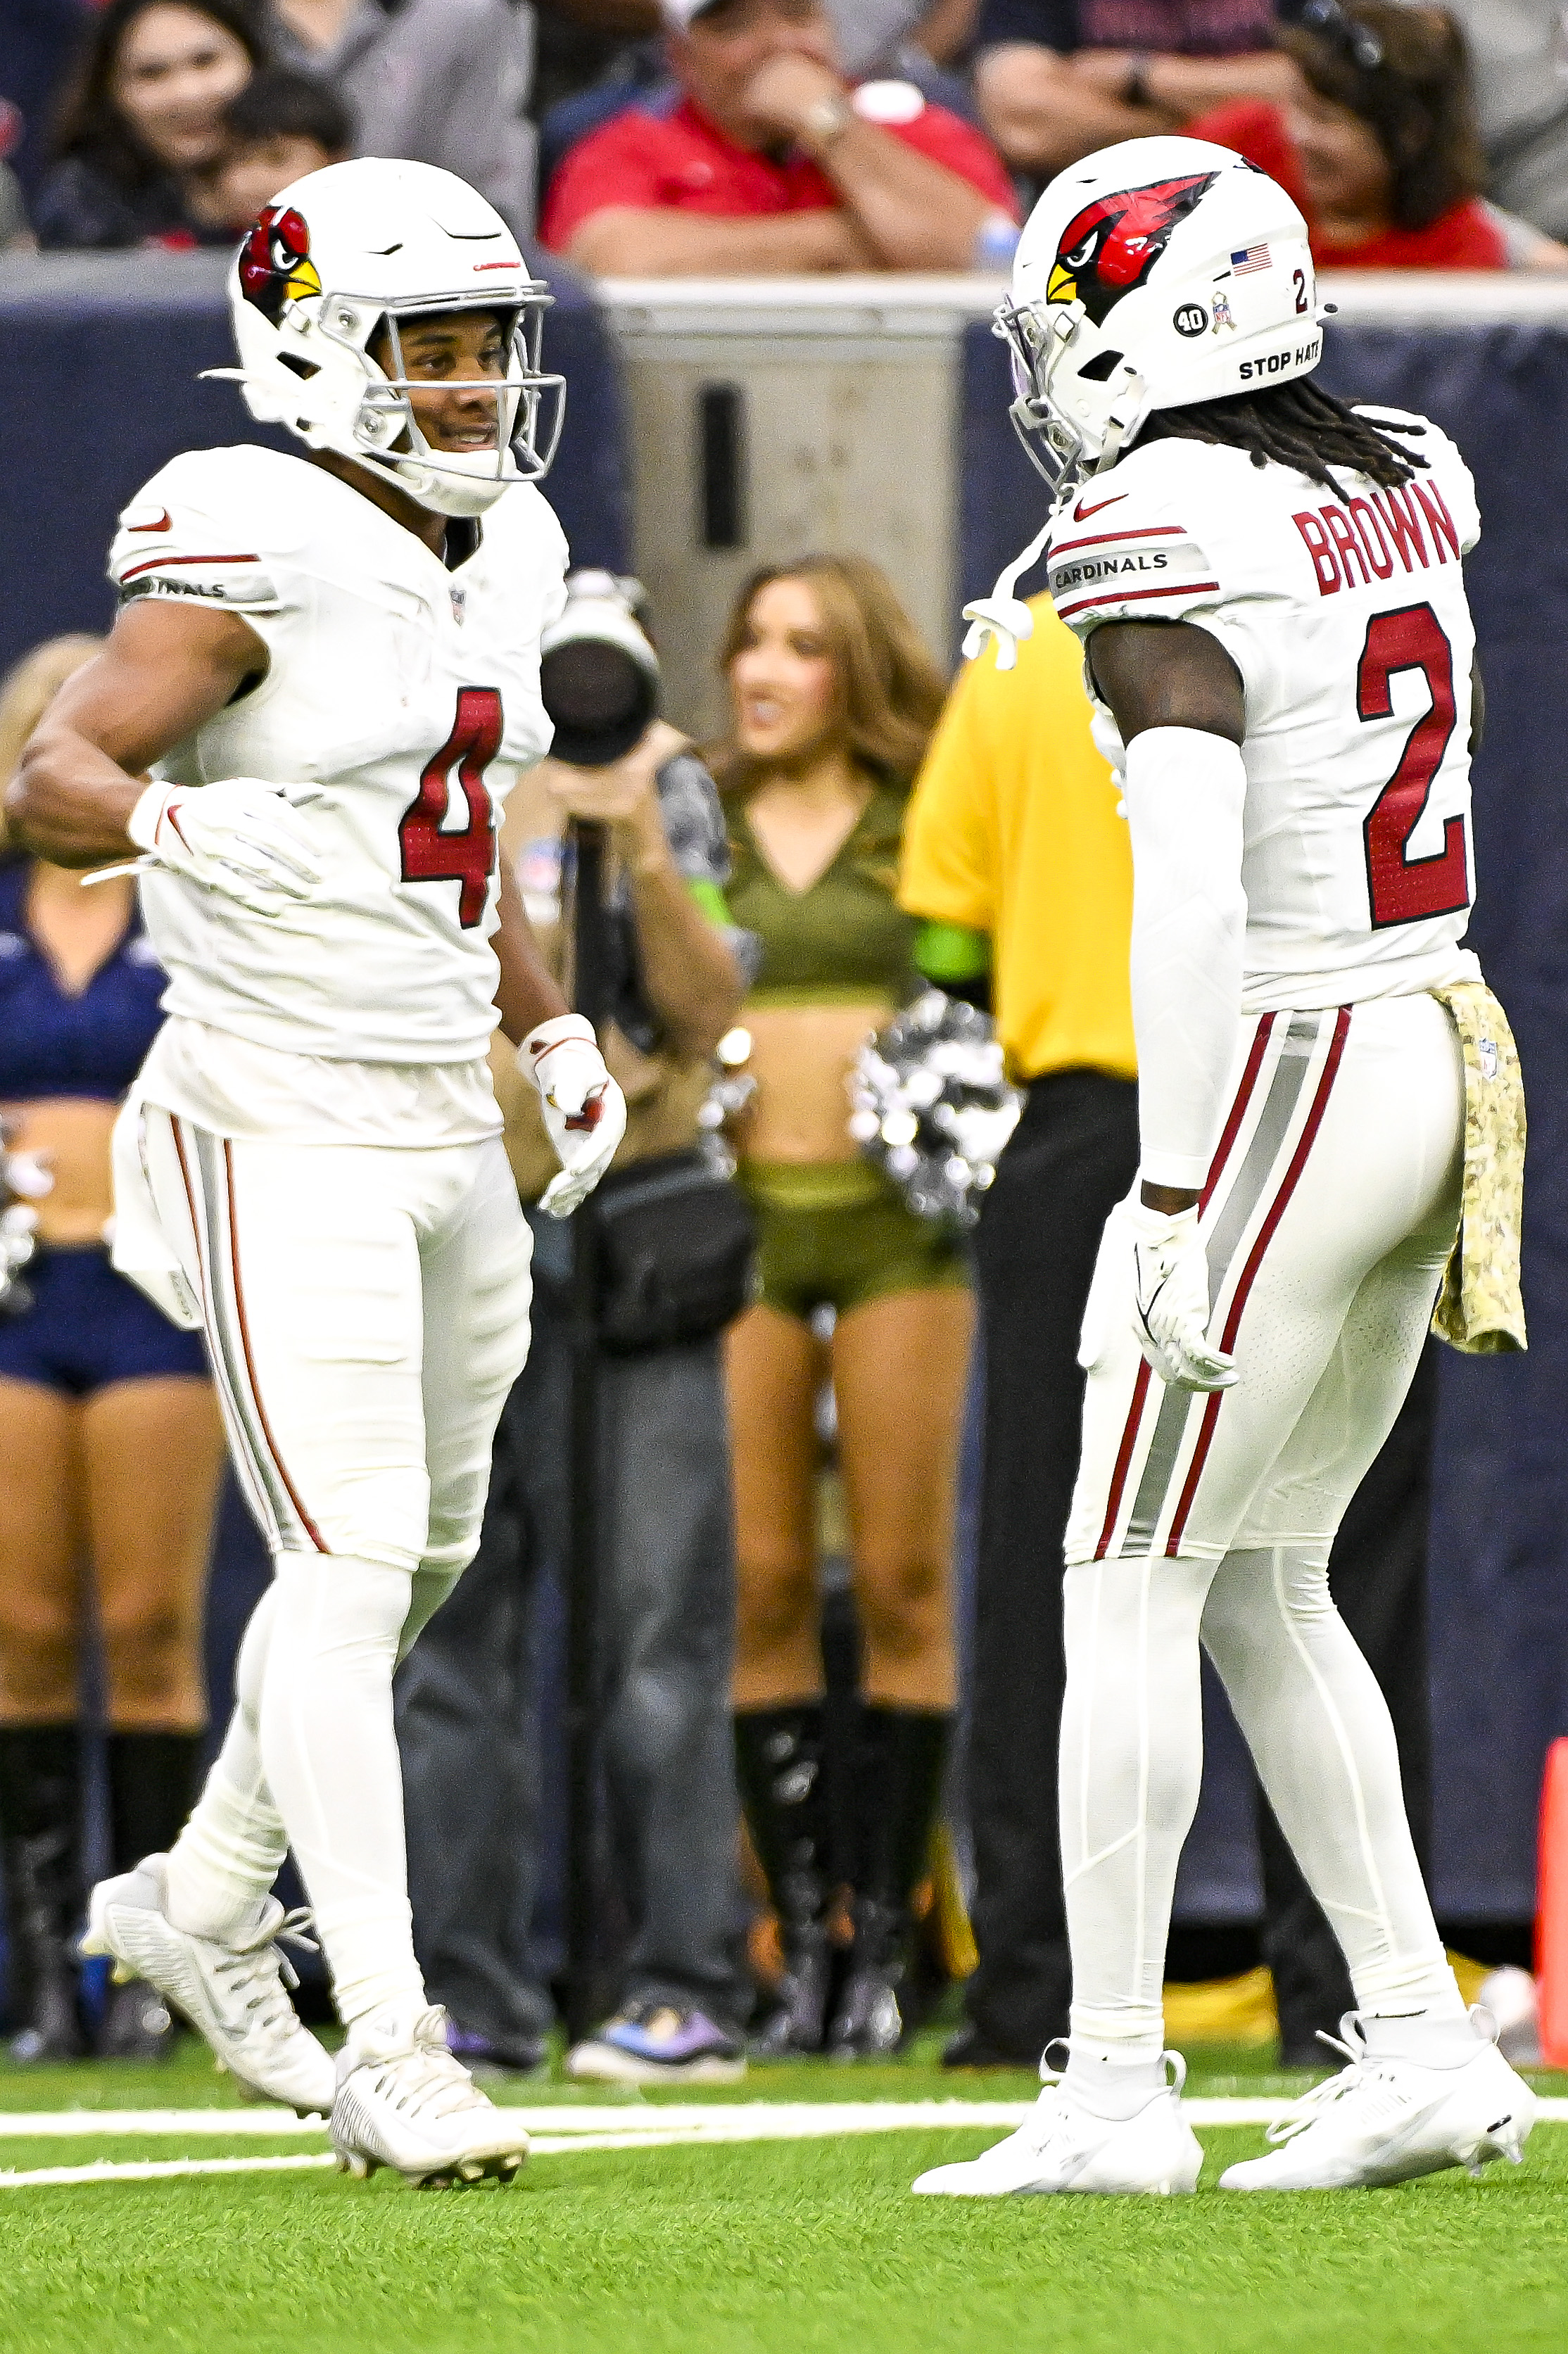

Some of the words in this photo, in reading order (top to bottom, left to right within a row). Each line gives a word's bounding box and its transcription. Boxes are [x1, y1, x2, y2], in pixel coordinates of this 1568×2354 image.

[1293, 268, 1308, 315] 2
[1177, 309, 1204, 331] 40
[1239, 352, 1291, 380] STOP
[1291, 479, 1460, 596] BROWN
[1055, 554, 1168, 588] CARDINALS
[1356, 601, 1470, 932] 2
[398, 685, 503, 930] 4
